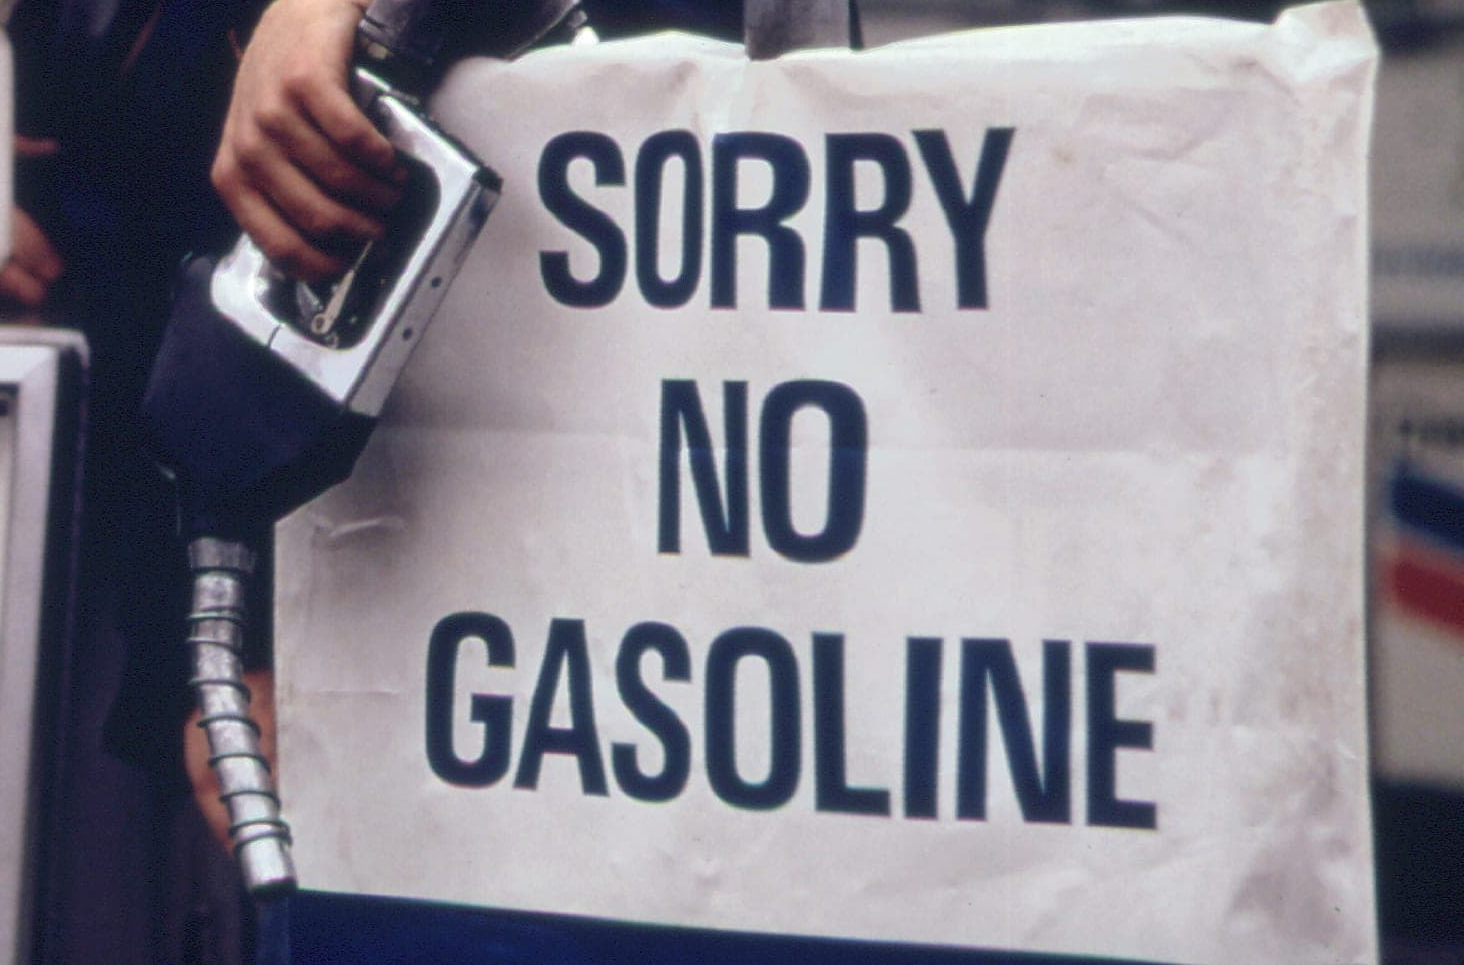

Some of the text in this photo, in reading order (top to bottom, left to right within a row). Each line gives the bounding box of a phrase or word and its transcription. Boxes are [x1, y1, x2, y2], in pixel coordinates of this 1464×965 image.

[537, 126, 1017, 314] SORRY
[656, 377, 870, 564] NO
[423, 609, 1160, 831] GASOLINE
